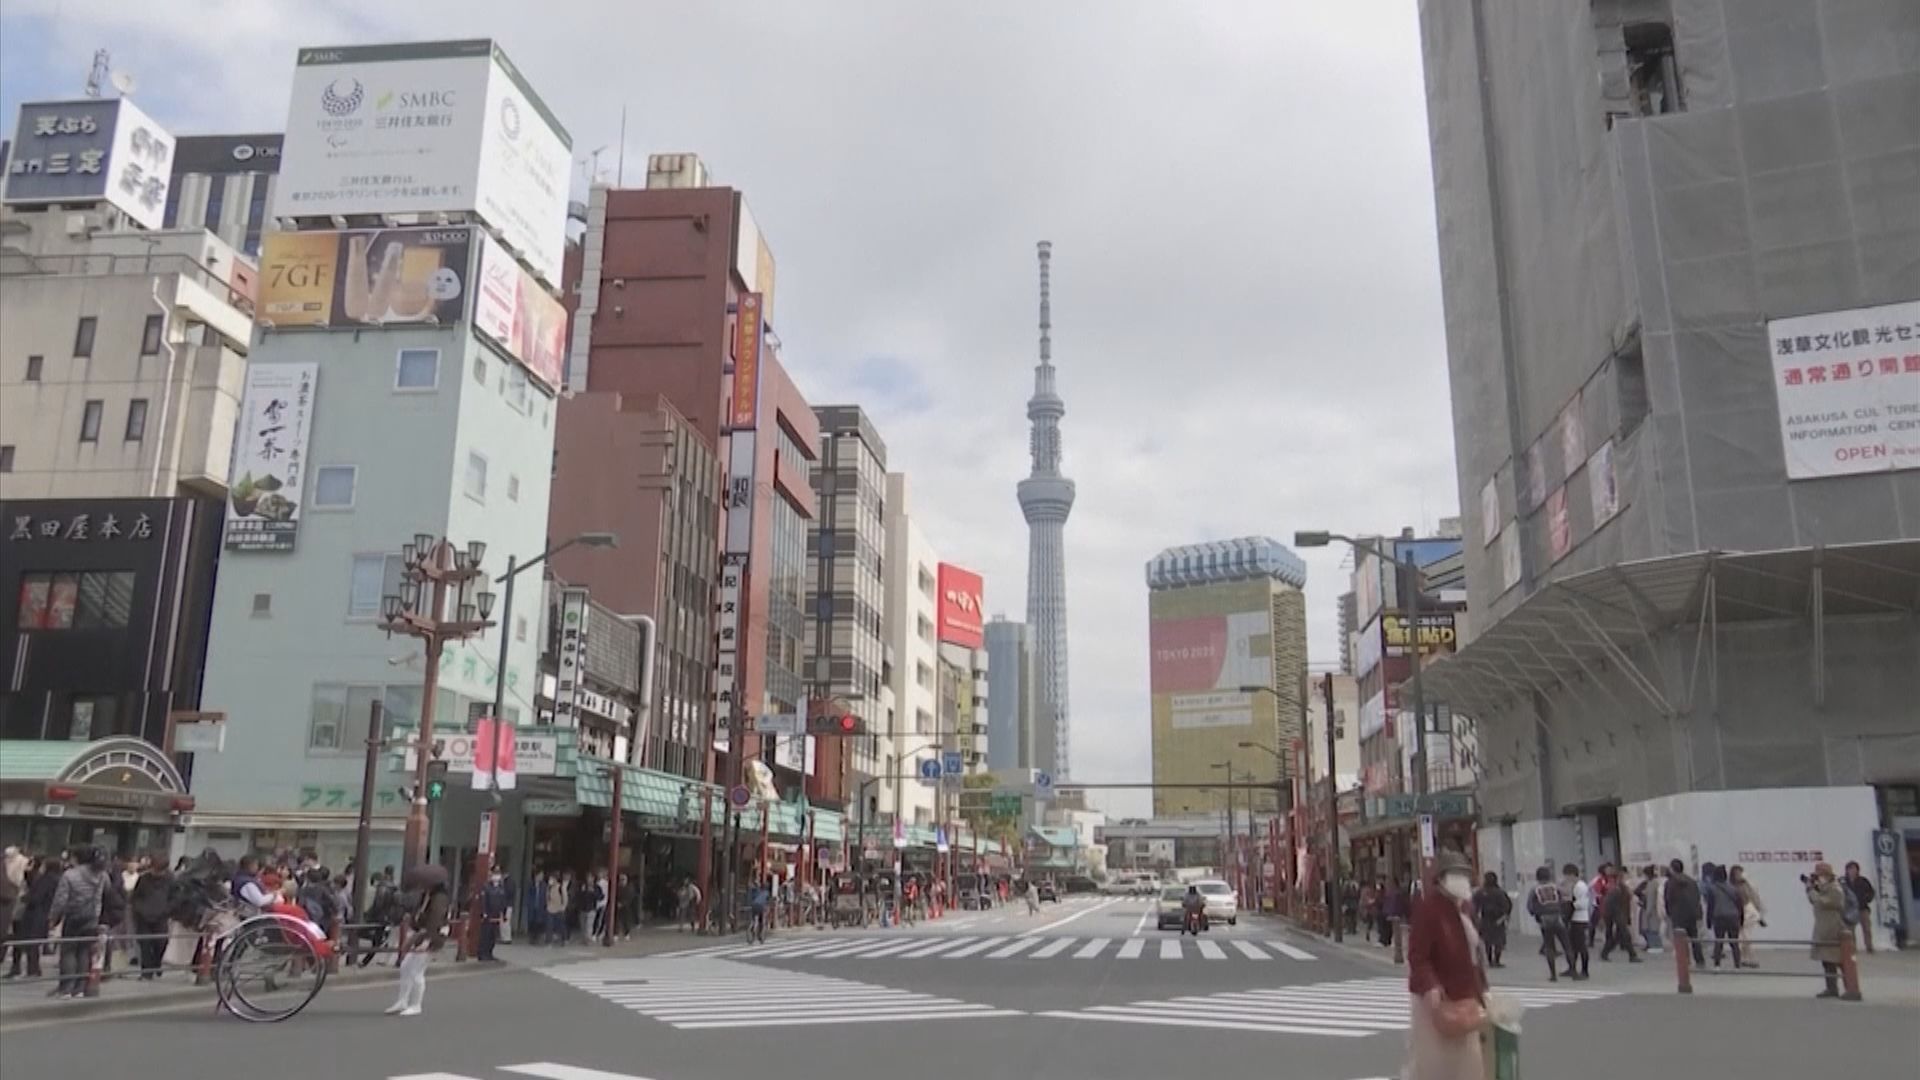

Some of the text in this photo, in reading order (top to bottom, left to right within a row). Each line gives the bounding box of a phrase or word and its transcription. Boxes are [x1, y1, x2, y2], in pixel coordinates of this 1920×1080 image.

[400, 90, 456, 108] SMBC
[375, 114, 452, 129] 三井住友銀行
[270, 263, 328, 289] 7GF
[1787, 411, 1848, 425] ASAKUSA
[1789, 423, 1877, 441] INFORMATION
[1834, 444, 1887, 461] OPEN
[10, 513, 153, 540] 黒田屋本店
